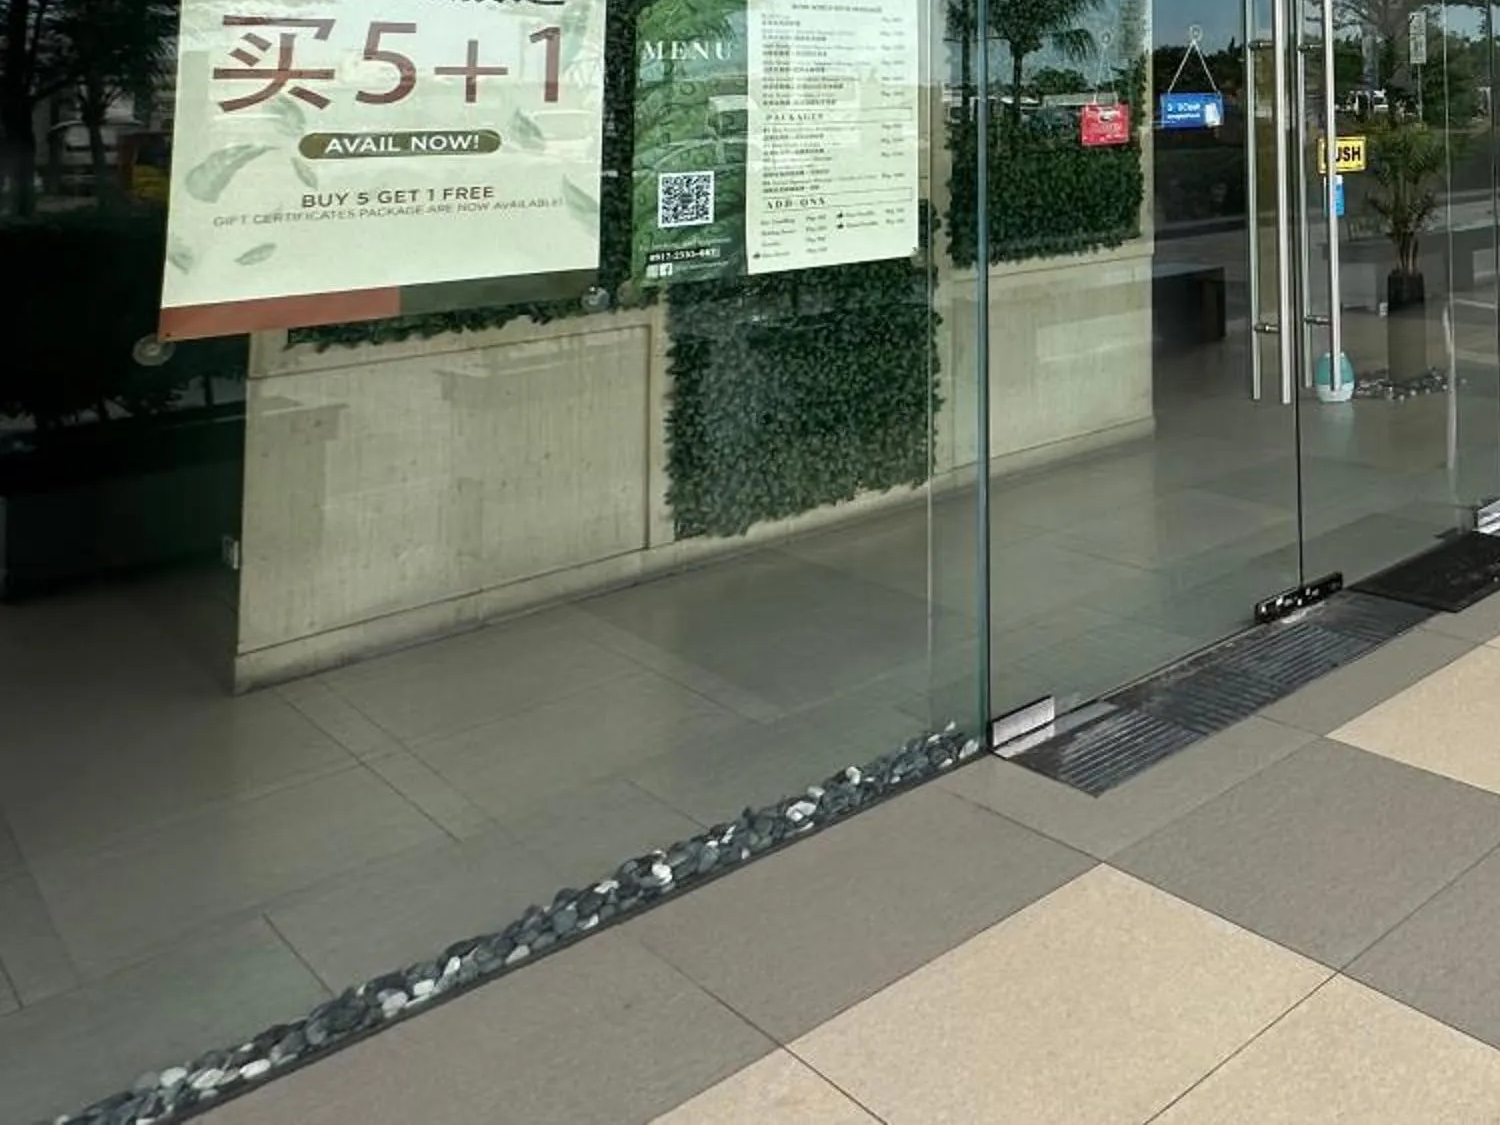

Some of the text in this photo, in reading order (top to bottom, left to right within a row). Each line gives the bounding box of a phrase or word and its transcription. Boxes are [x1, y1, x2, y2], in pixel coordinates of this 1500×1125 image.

[641, 40, 732, 61] MENU
[322, 133, 481, 154] AVAIL NOW!
[302, 186, 496, 209] BUY 5 GET 1 FREE
[213, 215, 247, 227] GIFT
[253, 209, 356, 225] CERTIFICATES
[359, 205, 425, 219] PACKAGE
[426, 203, 452, 215] ARE
[457, 201, 489, 213] NOW
